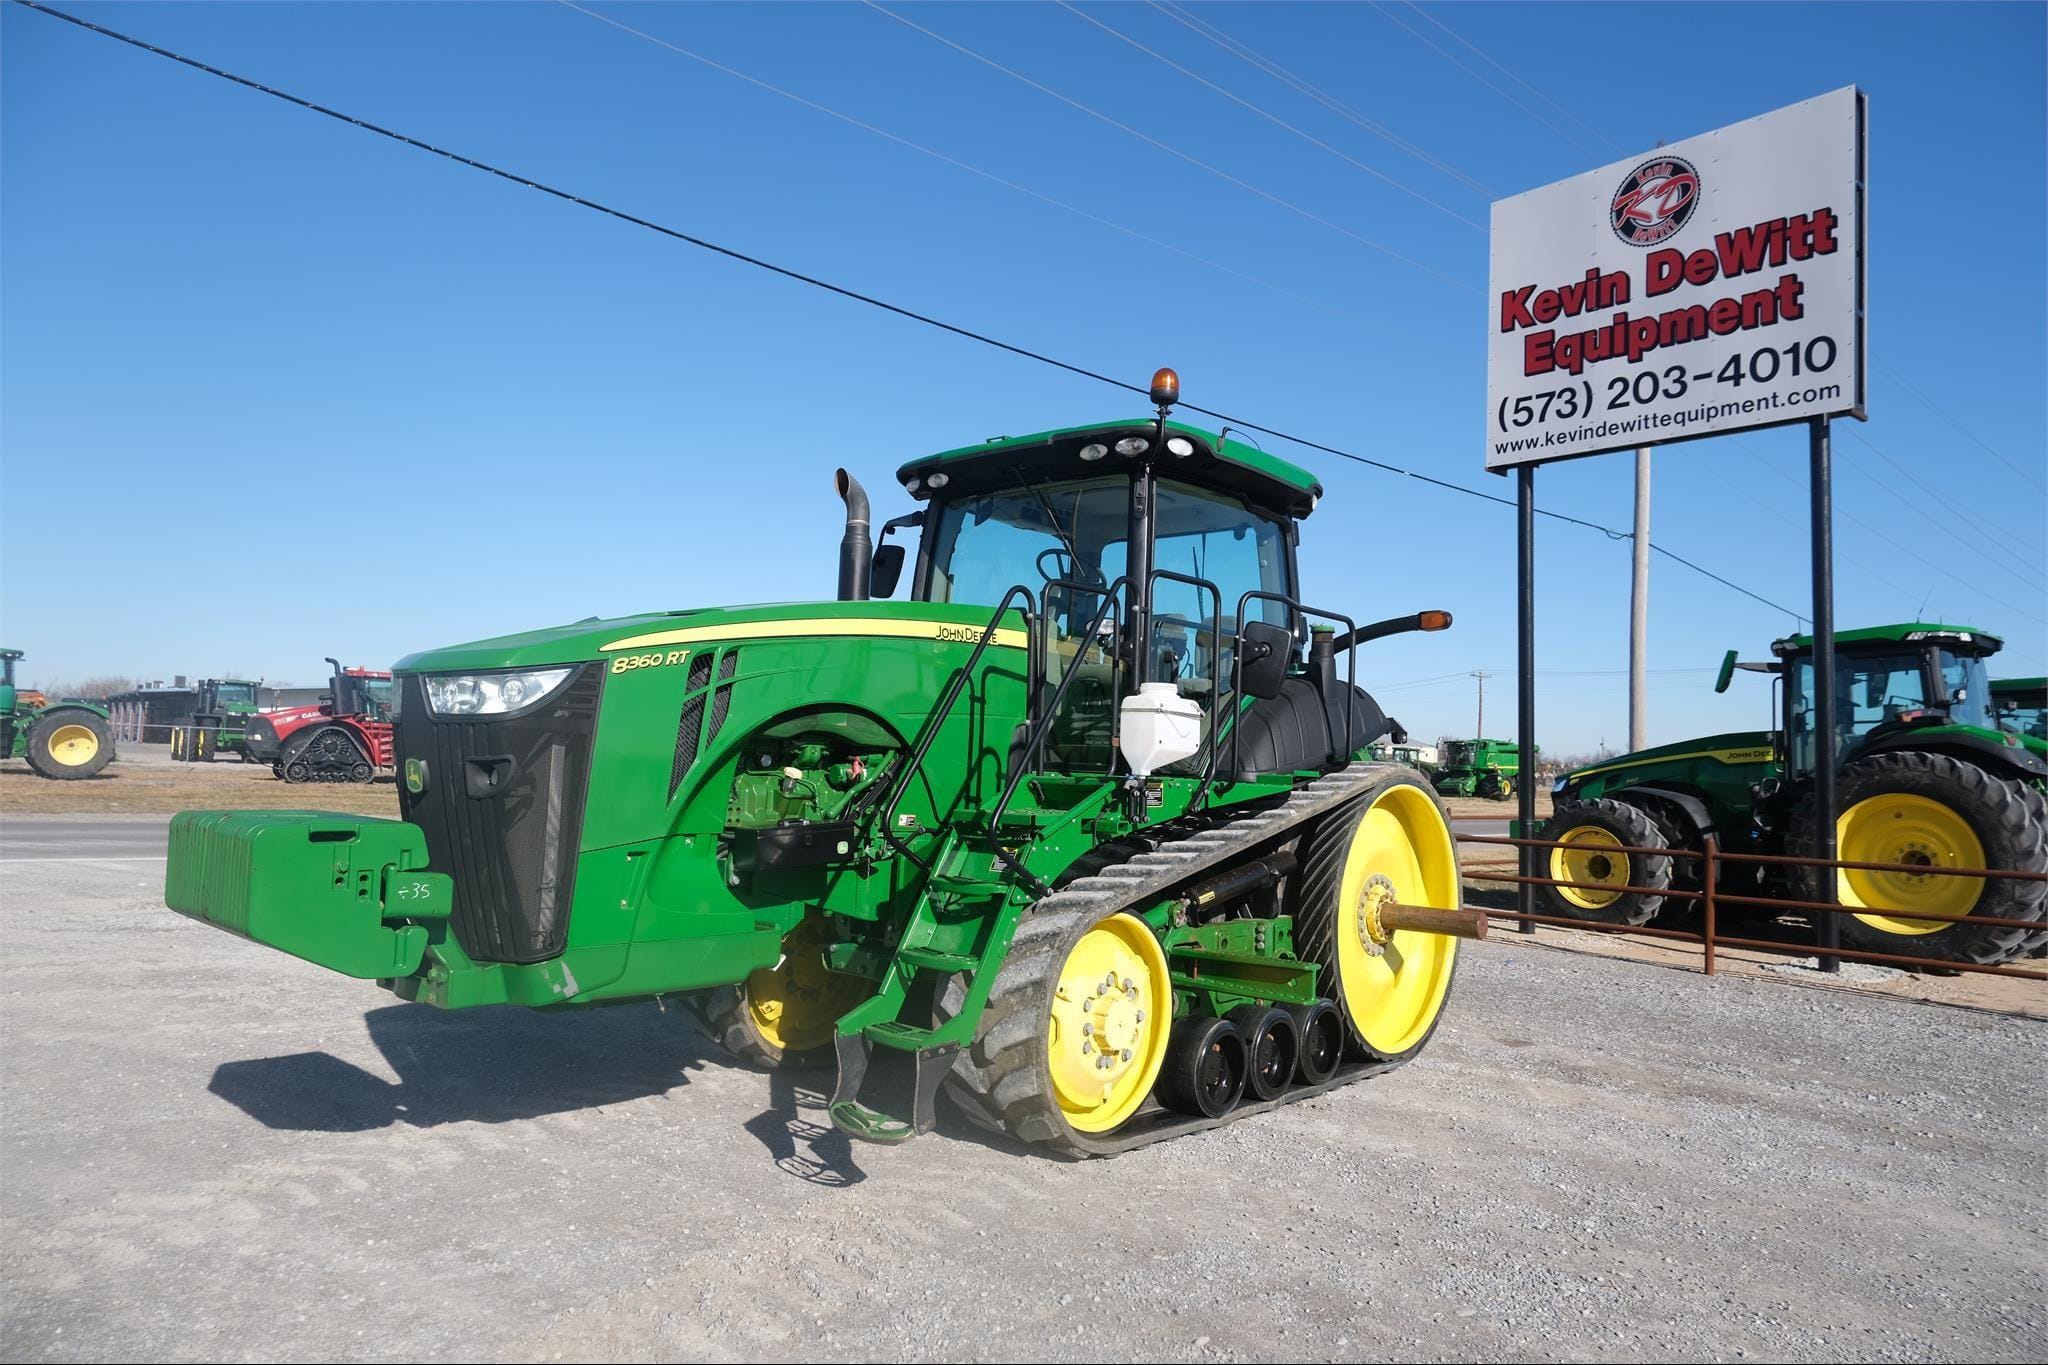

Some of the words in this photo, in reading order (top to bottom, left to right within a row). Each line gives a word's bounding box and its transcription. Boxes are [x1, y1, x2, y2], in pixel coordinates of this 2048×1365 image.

[1635, 163, 1674, 184] Kevin
[1501, 267, 1630, 333] Kevin
[1646, 207, 1838, 298] DeWitt
[1524, 273, 1804, 377] Equipment
[1498, 380, 1594, 433] (573)
[1607, 335, 1838, 411] 203-4010
[1495, 384, 1841, 455] www.kevindewittequipment.com
[935, 625, 964, 641] JOHN
[965, 627, 998, 644] DEE
[611, 653, 664, 674] 8360
[665, 649, 691, 667] RT
[1727, 750, 1752, 760] JOHN
